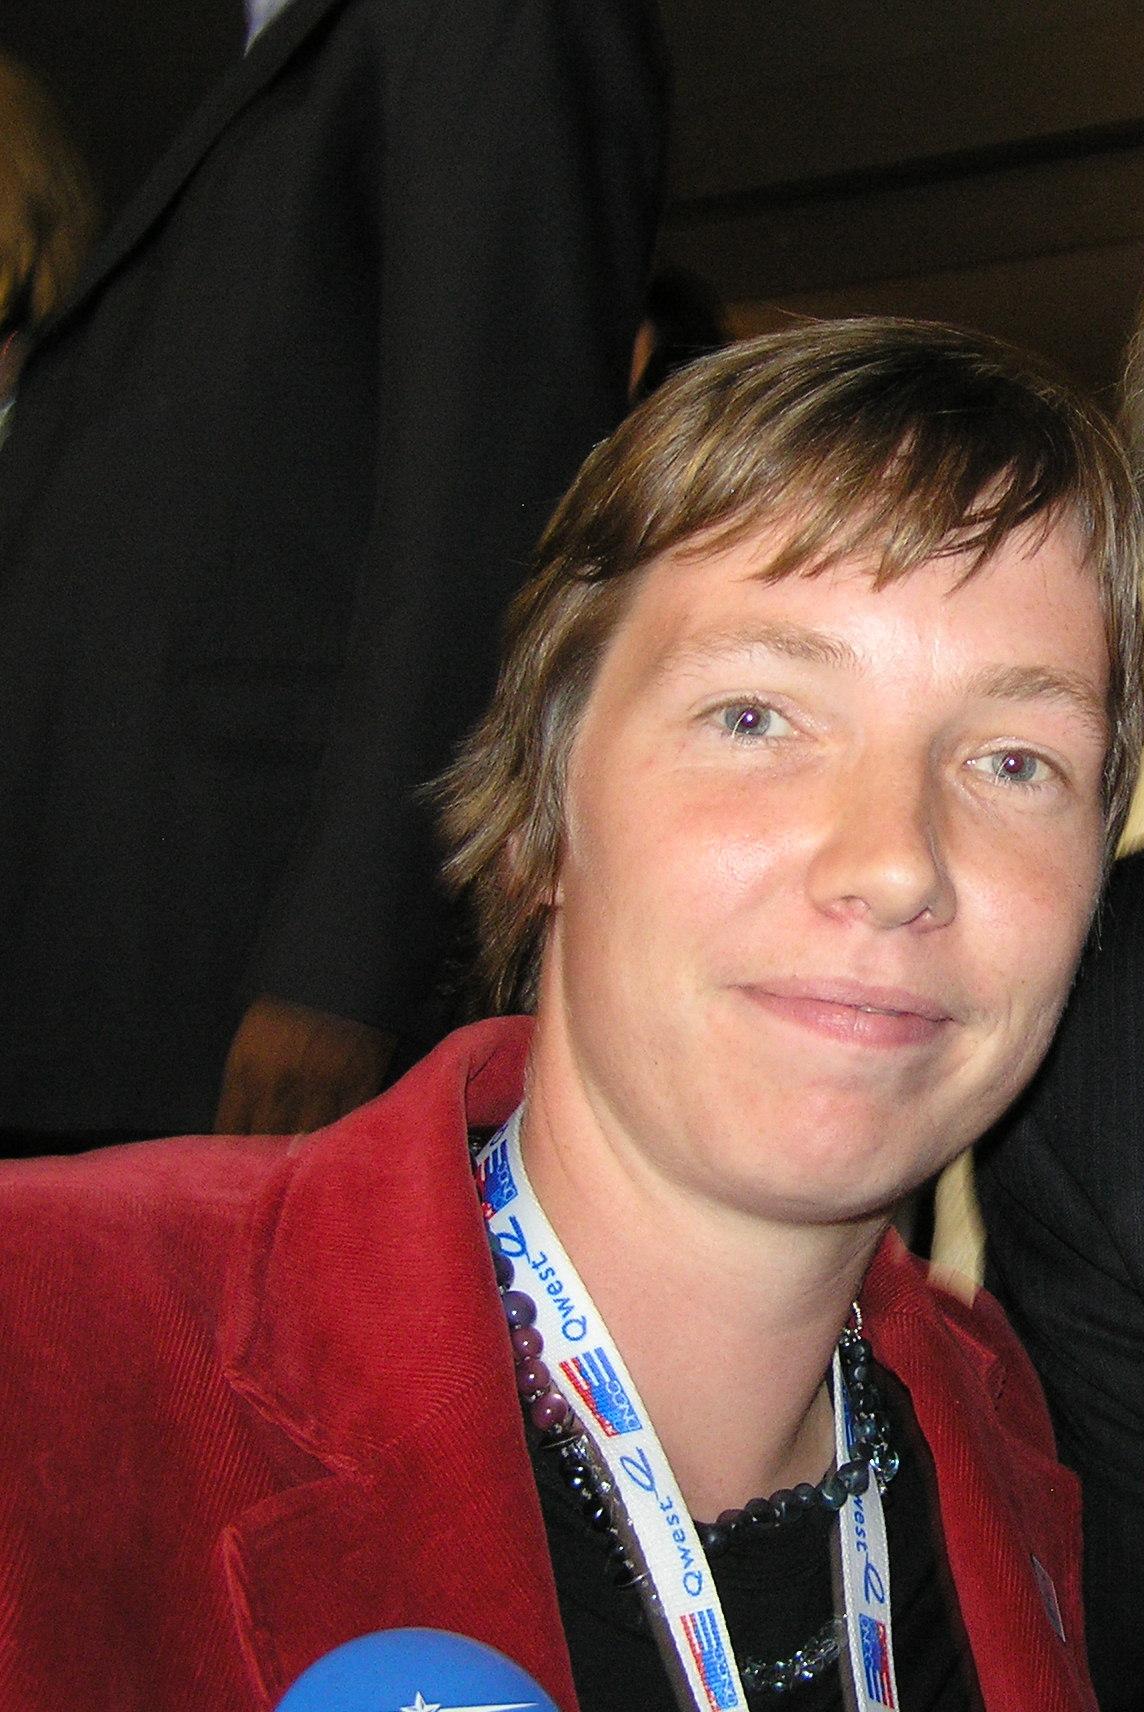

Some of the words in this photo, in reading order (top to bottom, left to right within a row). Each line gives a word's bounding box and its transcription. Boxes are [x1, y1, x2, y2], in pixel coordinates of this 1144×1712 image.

[531, 1250, 588, 1342] Qwest
[606, 1379, 641, 1432] DNCC
[659, 1496, 703, 1597] Qwest
[853, 1493, 868, 1552] west
